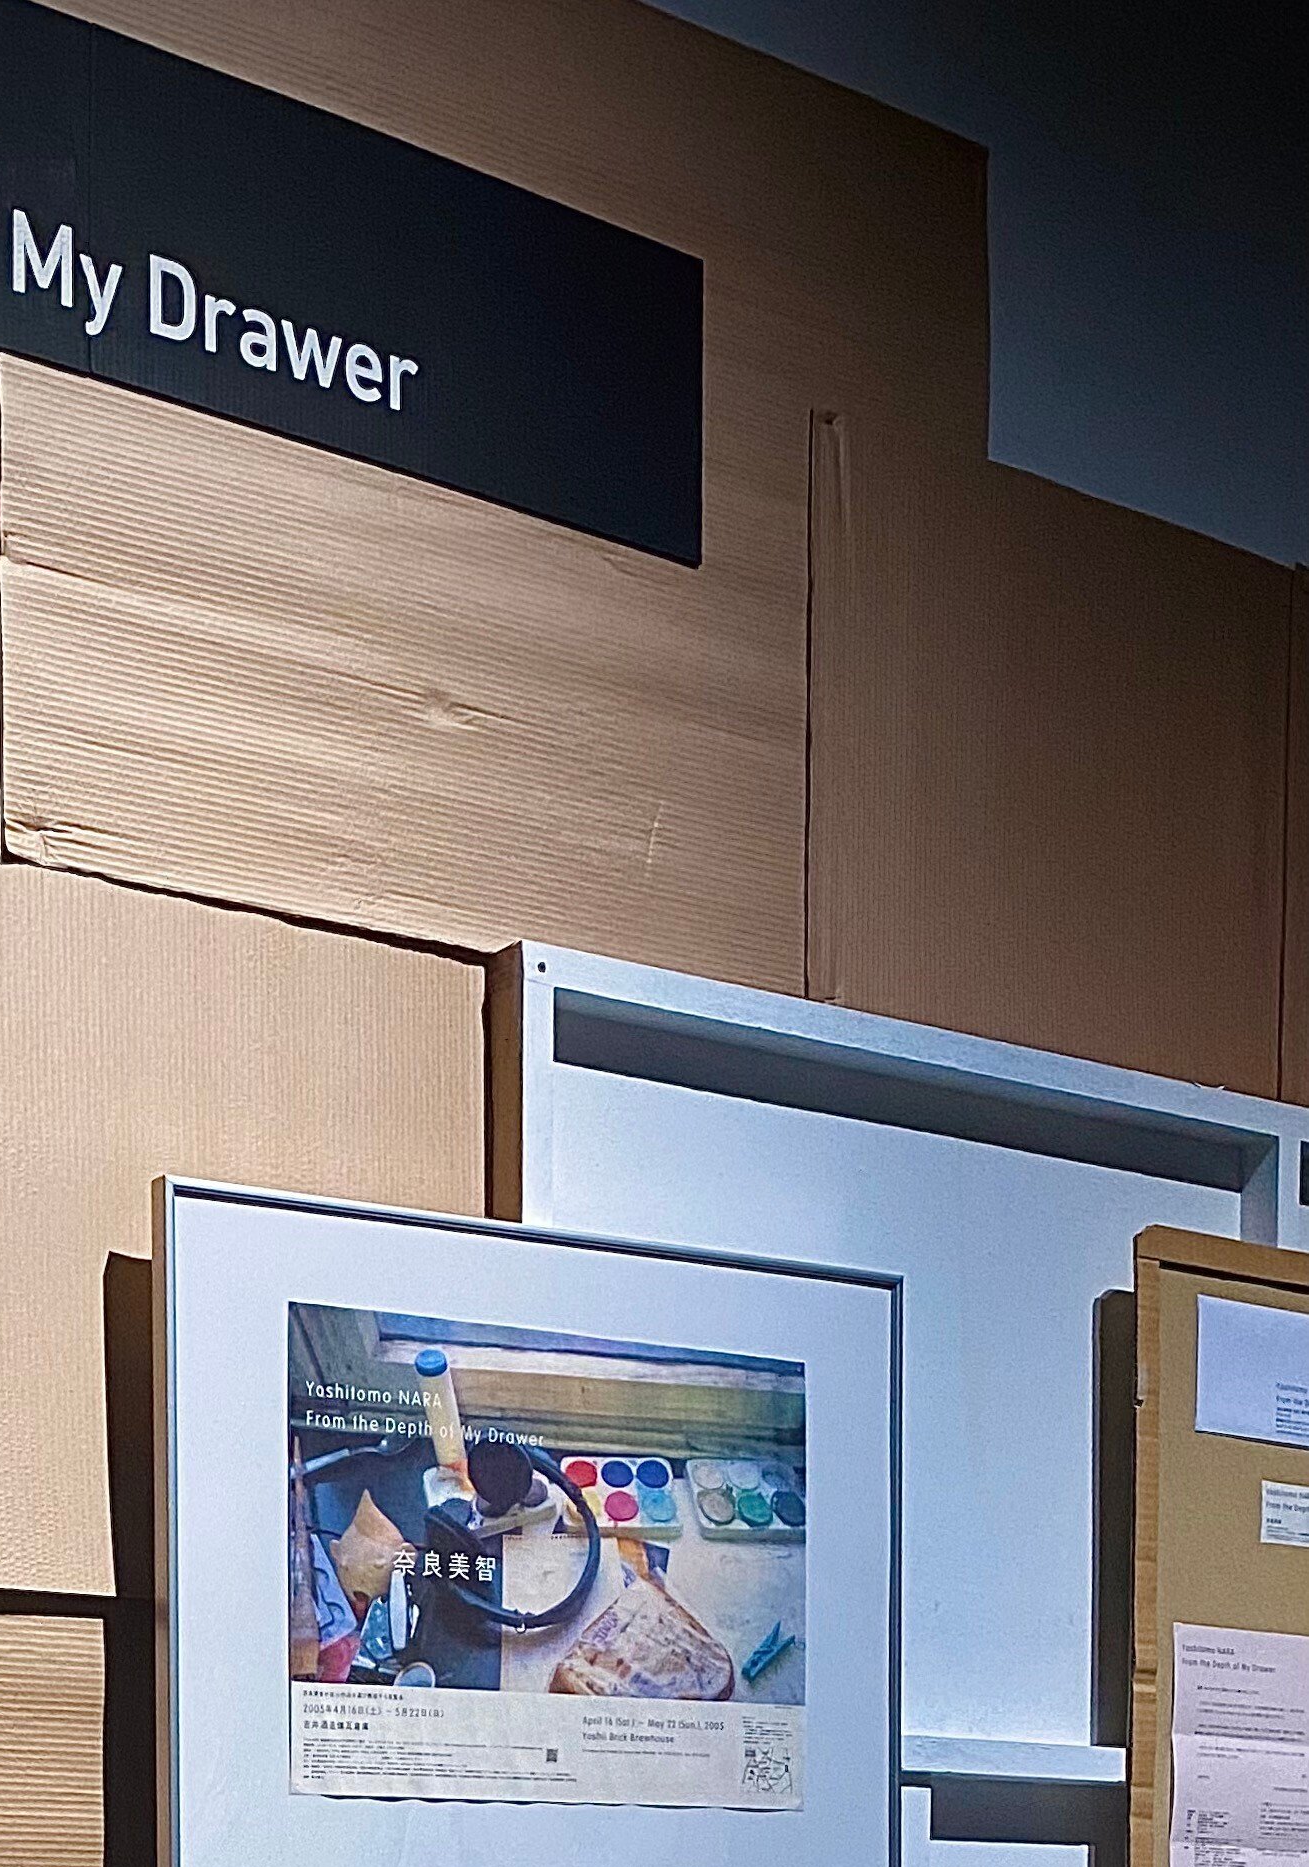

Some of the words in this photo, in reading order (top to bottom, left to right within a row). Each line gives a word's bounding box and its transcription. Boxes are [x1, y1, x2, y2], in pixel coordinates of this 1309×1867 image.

[12, 210, 122, 336] My
[150, 255, 419, 410] Drawer
[399, 1390, 442, 1409] NARA
[306, 1410, 346, 1430] From
[353, 1416, 378, 1432] the
[385, 1418, 432, 1438] Depth
[461, 1425, 482, 1444] My
[488, 1428, 544, 1447] Drawer
[393, 1550, 497, 1583] 奈良美智
